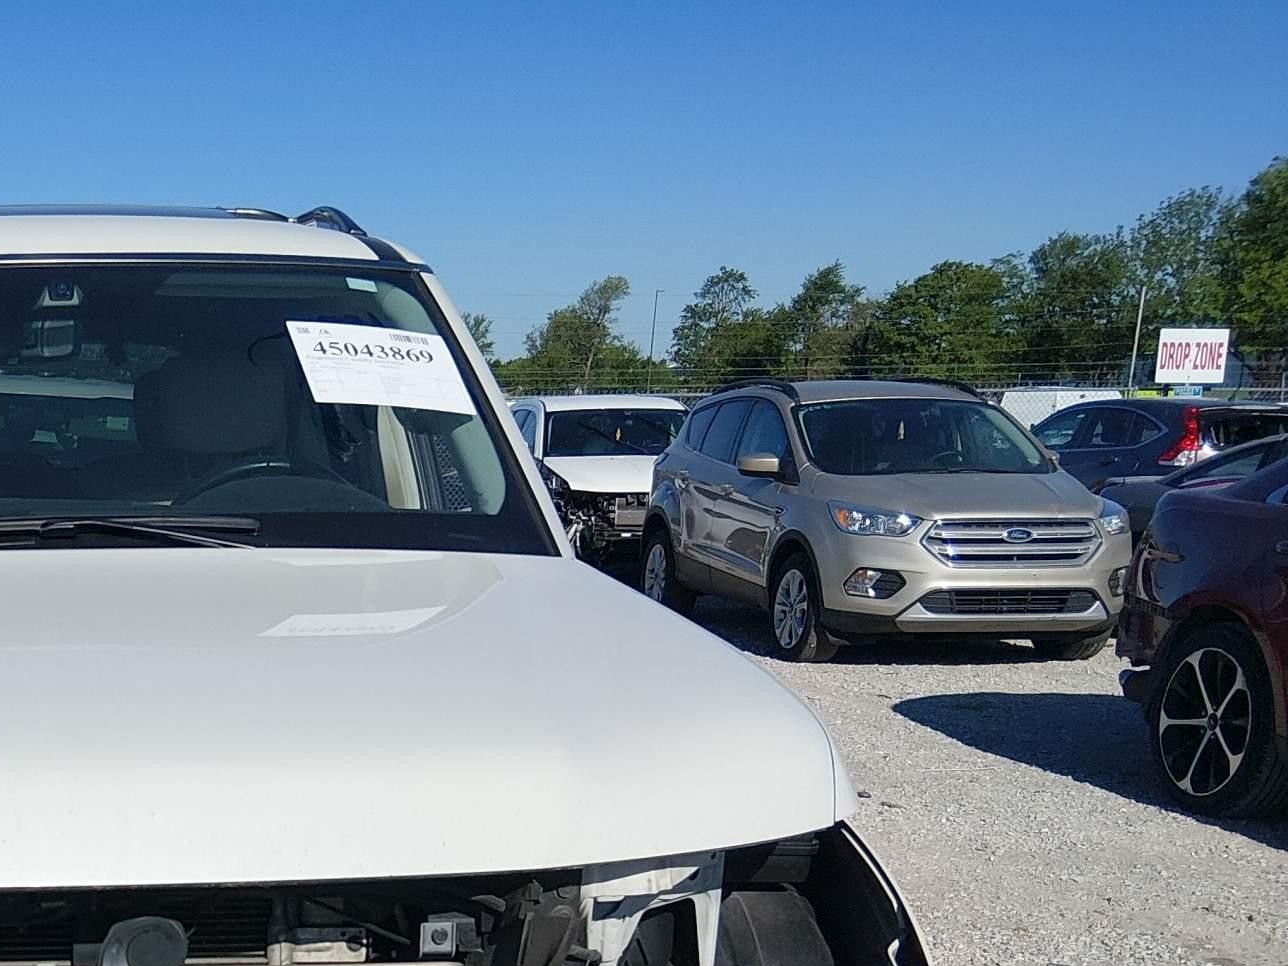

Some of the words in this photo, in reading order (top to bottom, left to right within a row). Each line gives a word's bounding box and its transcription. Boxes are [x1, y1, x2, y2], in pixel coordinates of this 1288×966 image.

[313, 340, 434, 363] 45043869
[1160, 342, 1191, 370] DROP
[1192, 342, 1224, 370] ZONE
